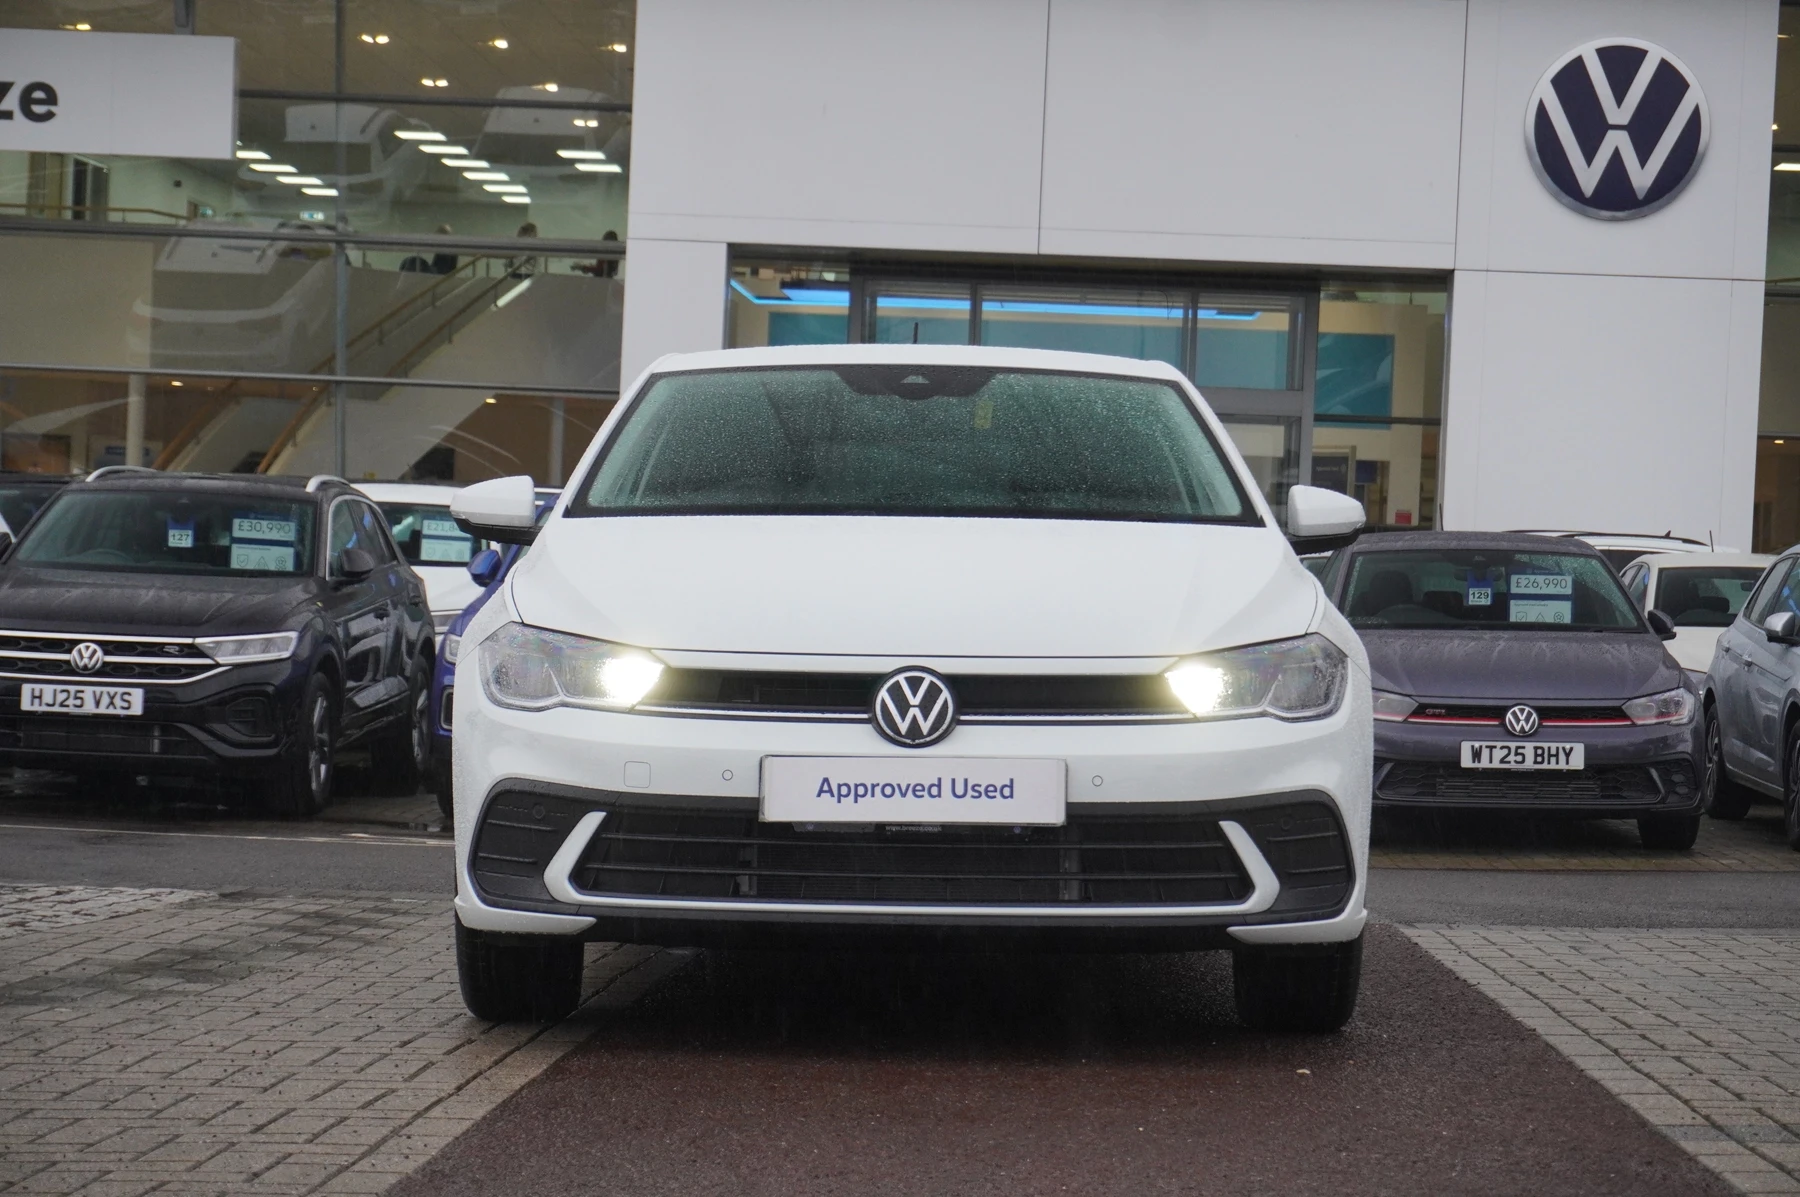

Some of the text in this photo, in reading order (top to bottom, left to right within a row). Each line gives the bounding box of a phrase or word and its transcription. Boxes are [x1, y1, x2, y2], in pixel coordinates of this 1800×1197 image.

[238, 521, 291, 534] £30,990
[171, 533, 190, 541] 127
[1515, 577, 1568, 590] £26,990
[1471, 591, 1490, 600] 129
[30, 687, 133, 711] HJ25 VXS
[878, 673, 951, 737] VW
[1470, 744, 1575, 766] WT25 BHY
[816, 776, 1015, 804] Approved Used
